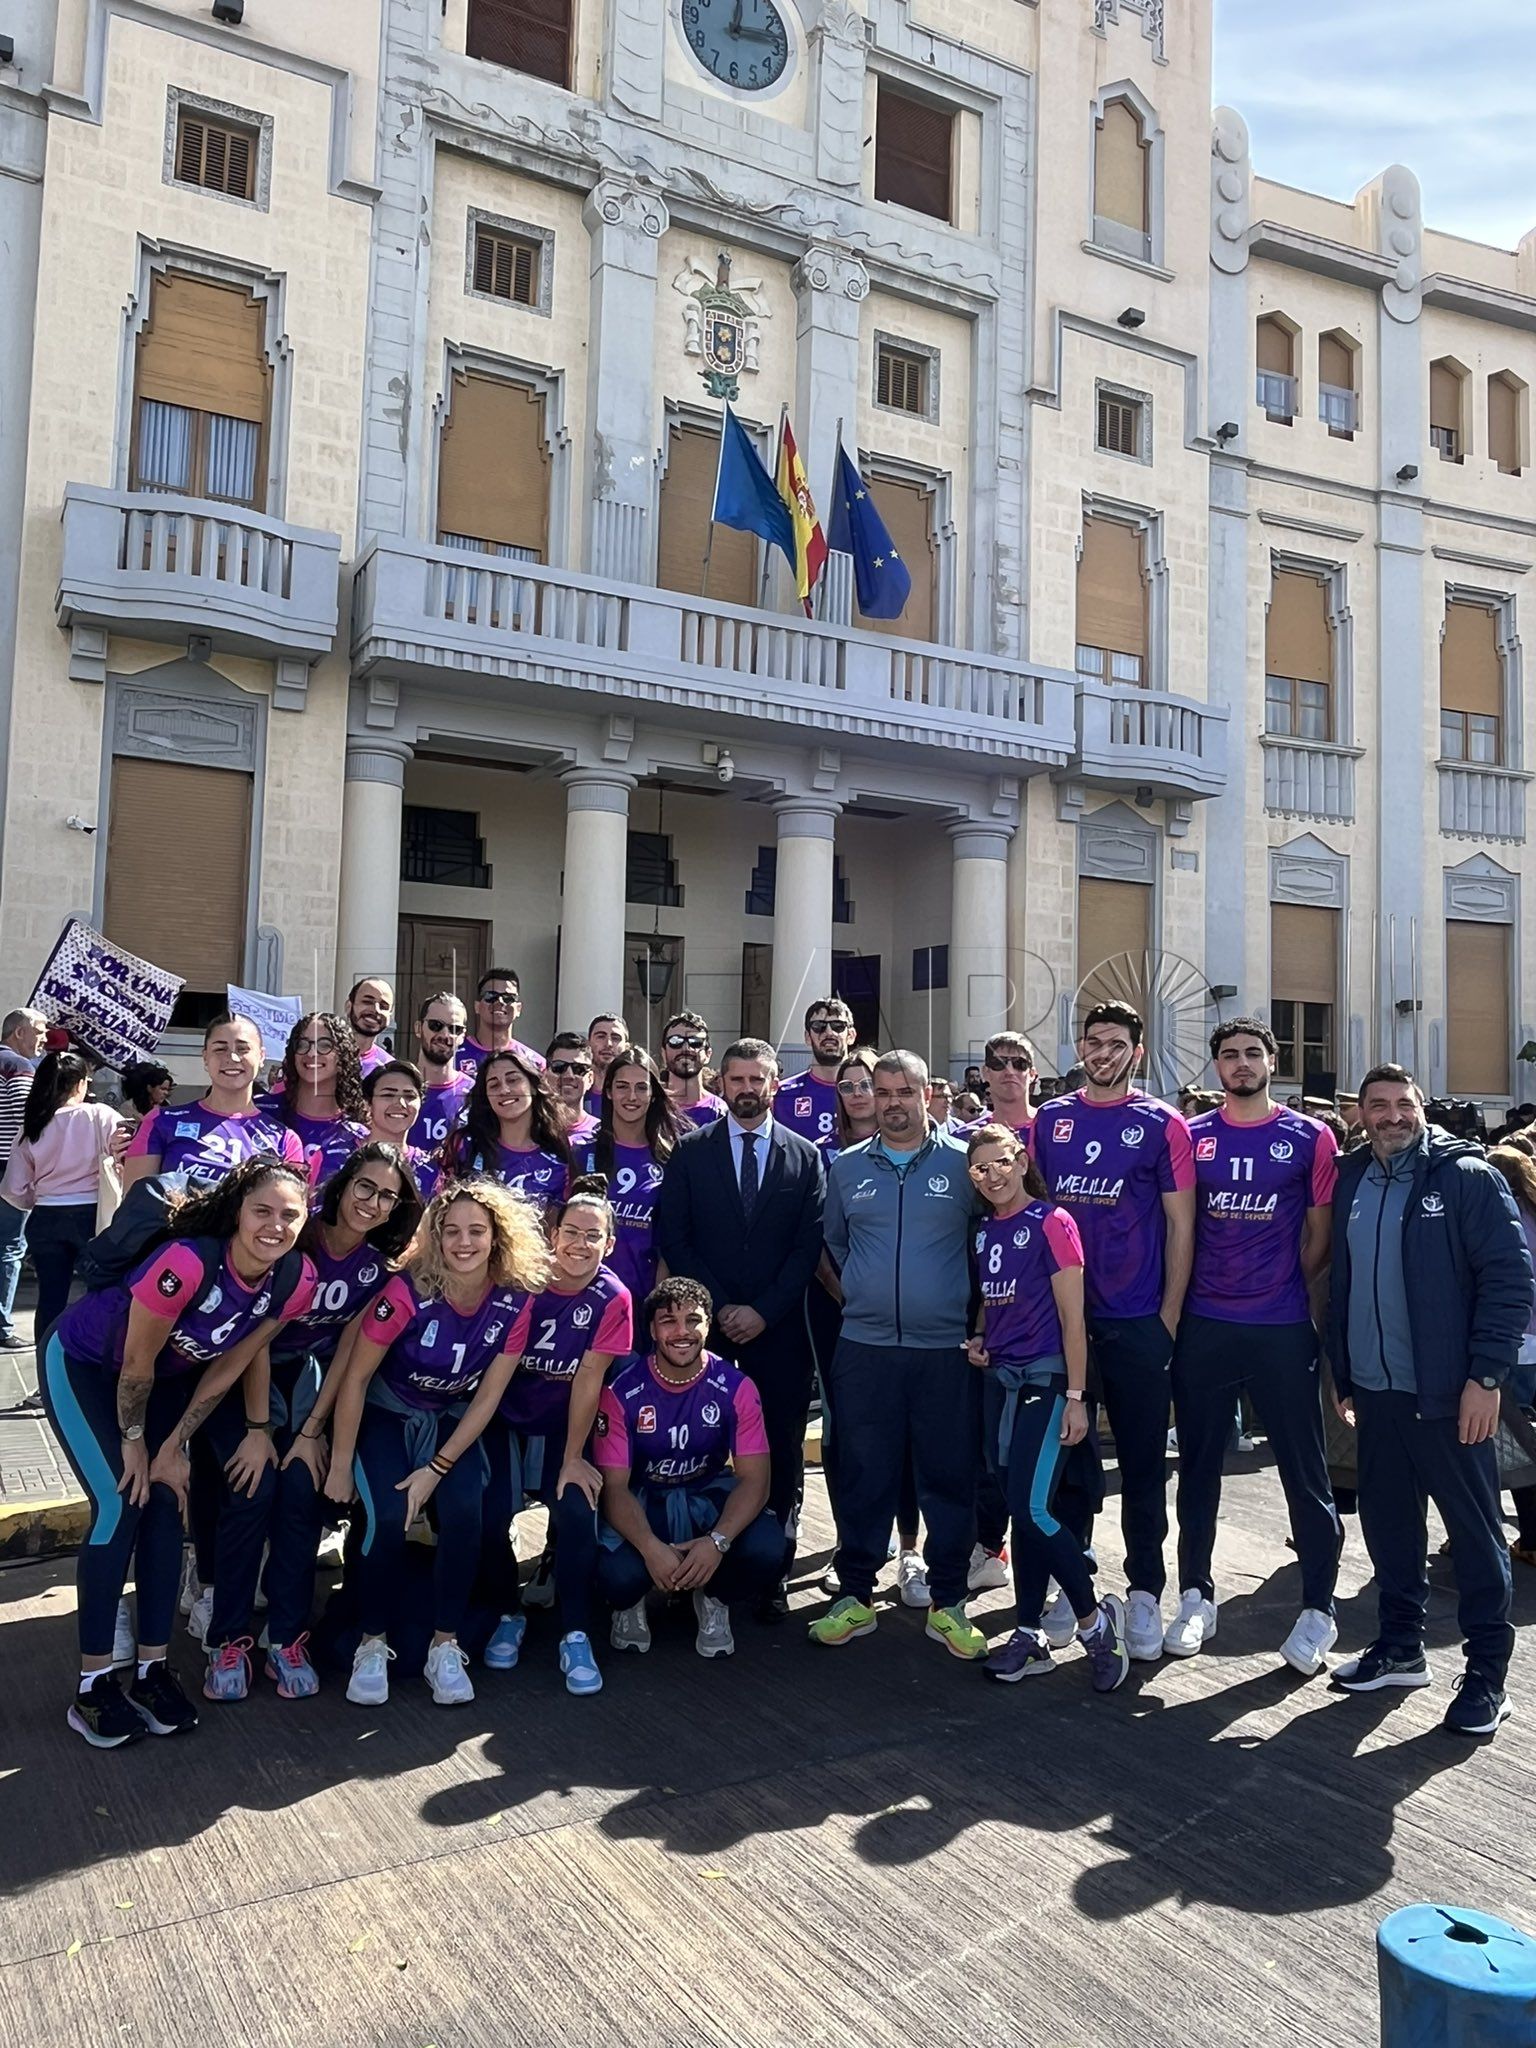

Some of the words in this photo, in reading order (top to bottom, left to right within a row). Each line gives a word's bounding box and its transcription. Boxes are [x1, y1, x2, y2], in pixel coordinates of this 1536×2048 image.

[690, 6, 699, 24] 9
[765, 15, 775, 32] 2
[695, 29, 705, 48] 8
[771, 38, 781, 56] 3
[710, 48, 720, 72] 7
[729, 61, 739, 80] 6
[762, 57, 772, 74] 4
[748, 64, 758, 82] 5
[44, 978, 77, 1007] DE
[423, 1117, 448, 1140] 16
[818, 1112, 833, 1133] 8
[199, 1135, 242, 1165] 21
[1084, 1140, 1102, 1165] 9
[616, 1167, 637, 1195] 9
[1230, 1157, 1254, 1182] 11
[1055, 1174, 1124, 1199] MELILLA
[1207, 1191, 1278, 1213] MELILLA
[988, 1243, 1003, 1274] 8
[311, 1279, 349, 1311] 10
[211, 1312, 243, 1345] 6
[533, 1318, 557, 1351] 2
[451, 1343, 466, 1374] 1
[667, 1424, 689, 1450] 10
